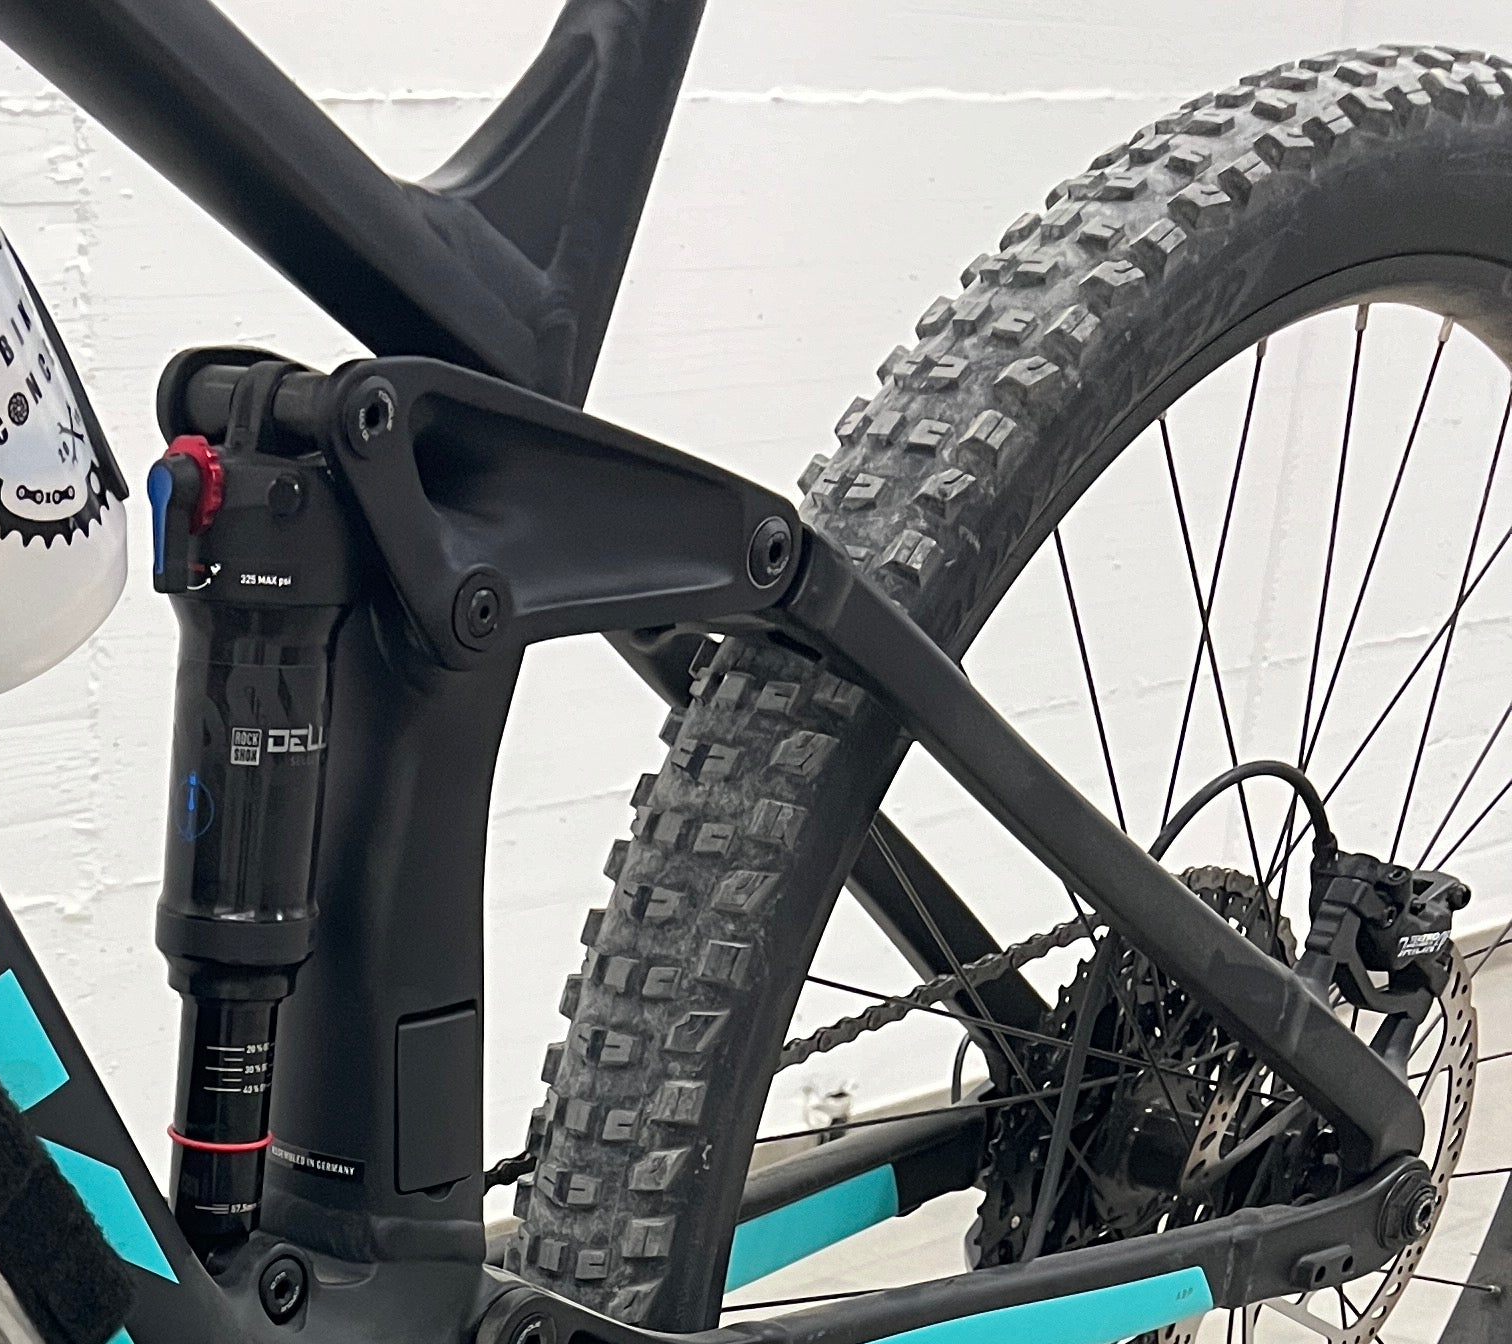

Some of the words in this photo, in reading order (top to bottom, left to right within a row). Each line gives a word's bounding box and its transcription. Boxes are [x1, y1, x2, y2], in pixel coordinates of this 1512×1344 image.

[240, 574, 257, 585] 325
[257, 575, 278, 586] MAX
[278, 575, 292, 588] psi
[234, 730, 259, 747] ROCK
[234, 748, 257, 762] SHOX
[306, 1157, 315, 1169] IN
[316, 1159, 356, 1176] GERMANY
